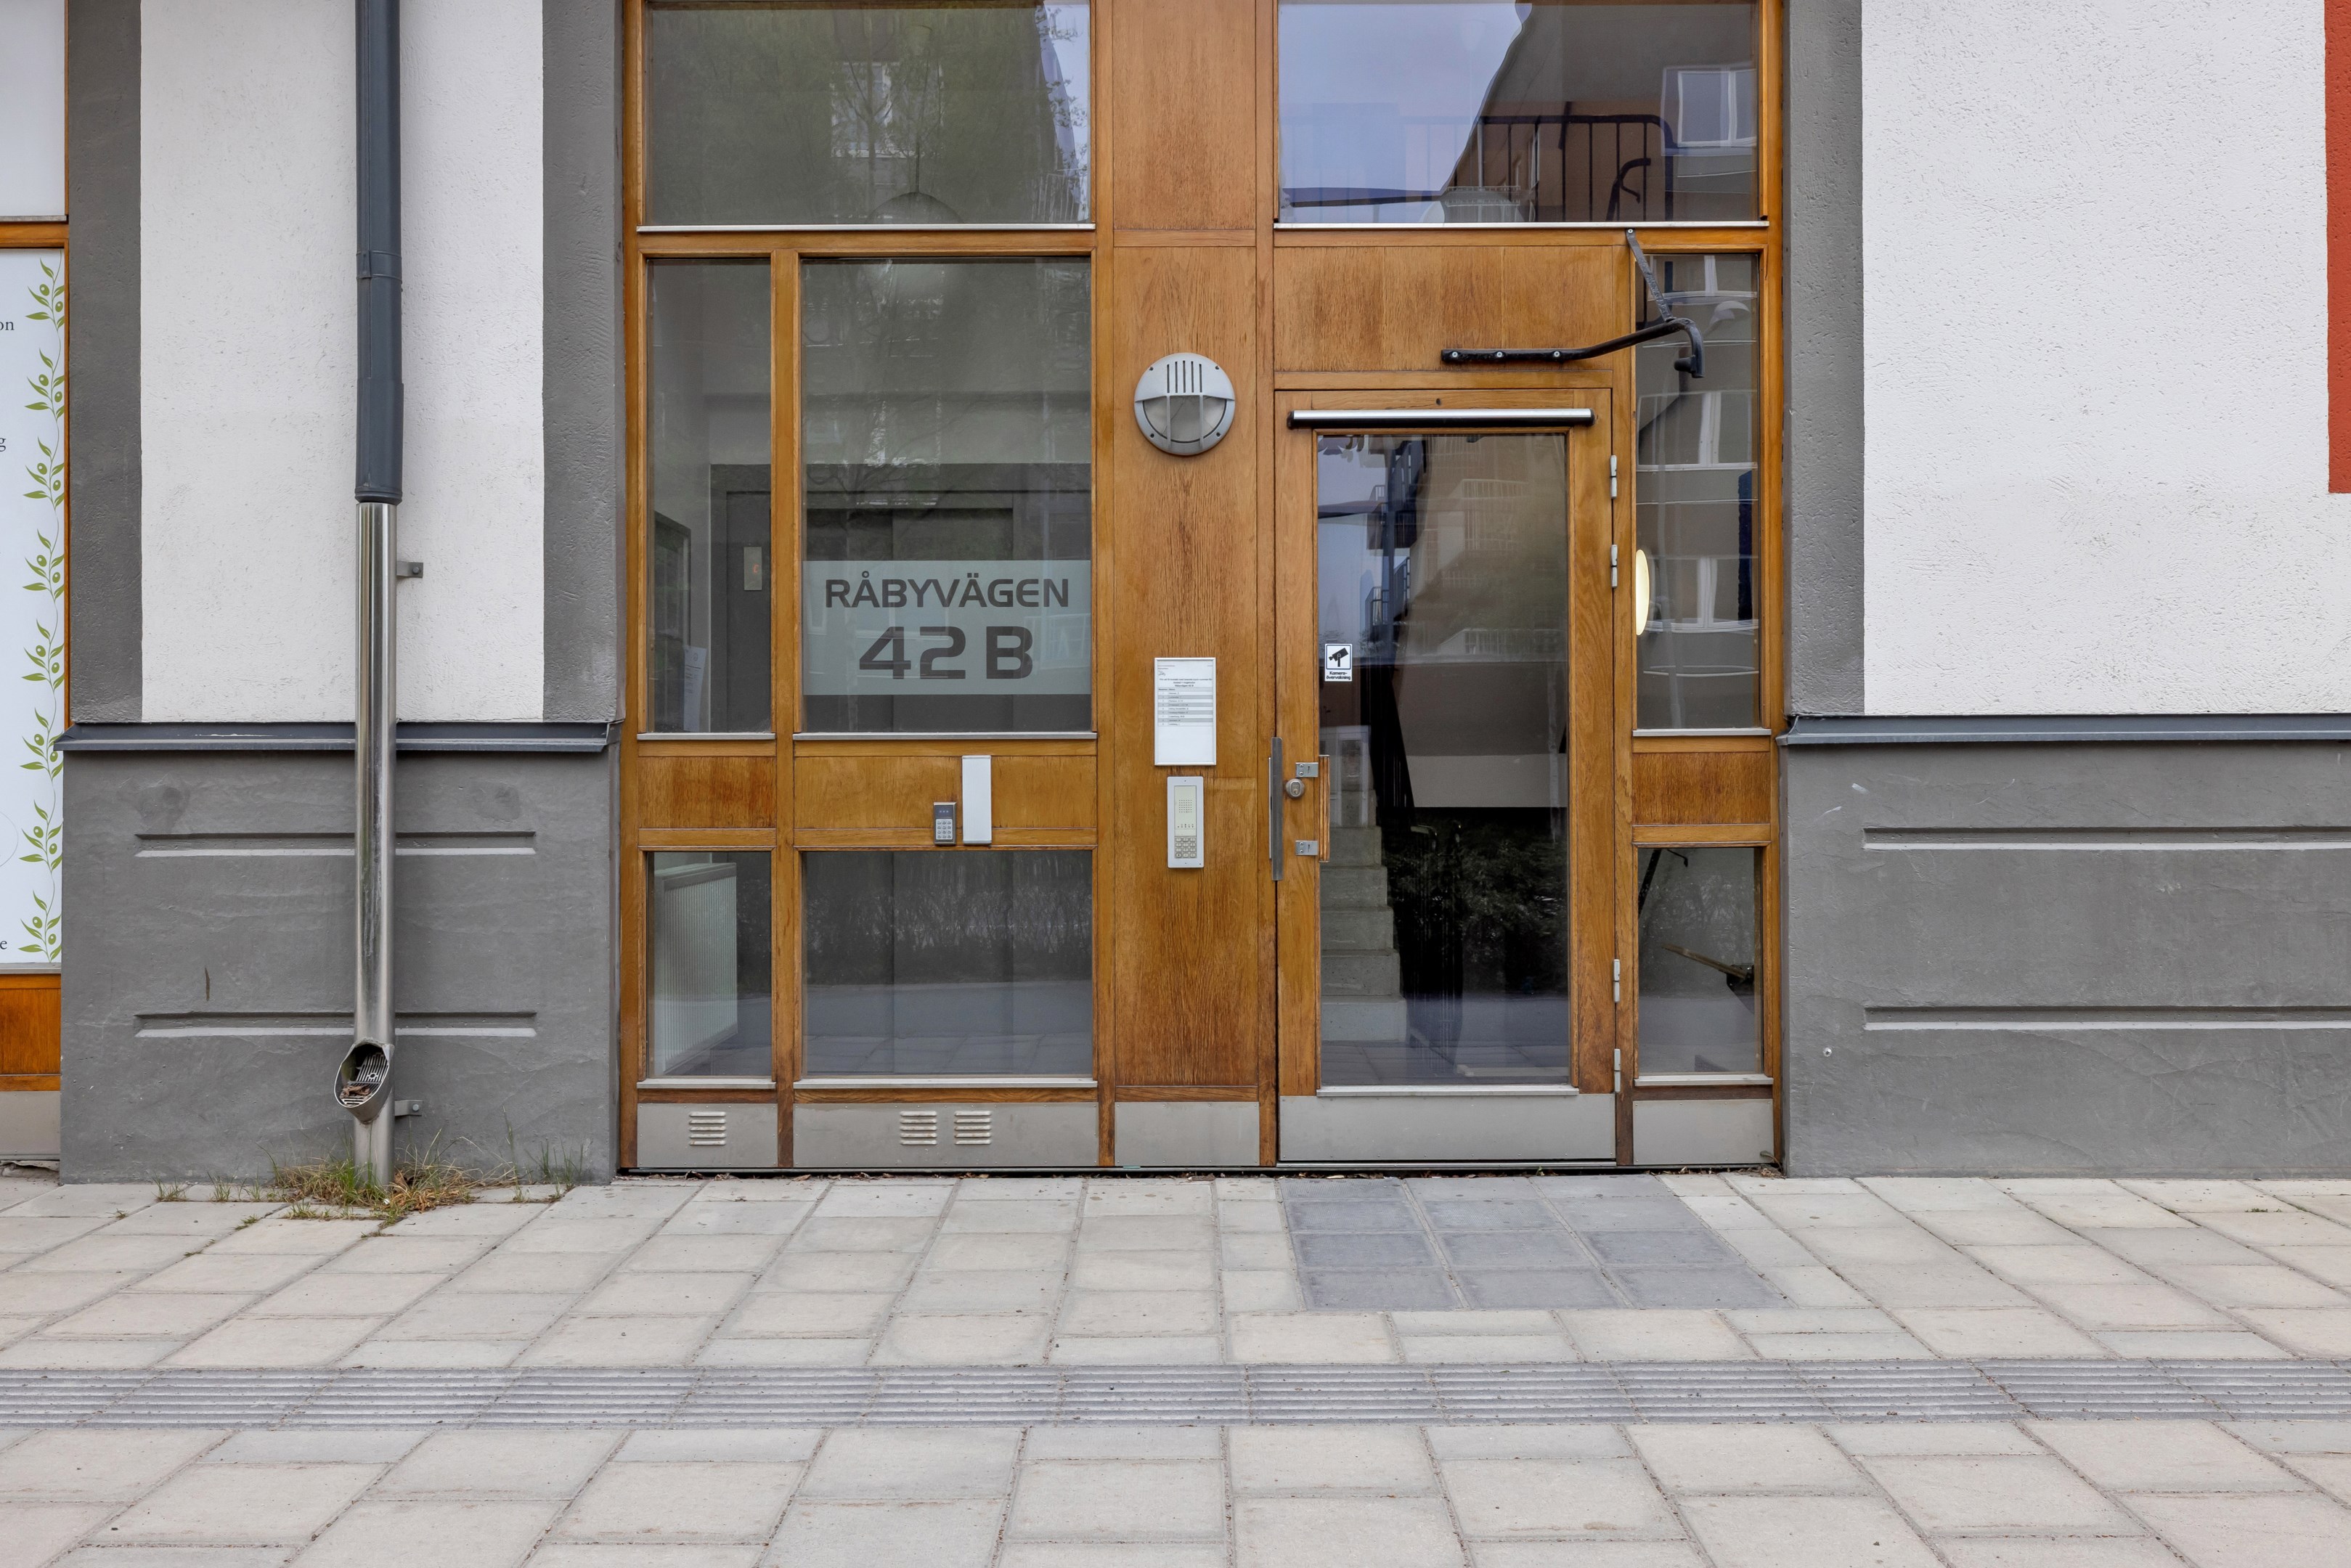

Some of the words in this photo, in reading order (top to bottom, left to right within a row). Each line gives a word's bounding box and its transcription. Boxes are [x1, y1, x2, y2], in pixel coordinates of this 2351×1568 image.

[825, 570, 1069, 608] RÅBYVÄGEN
[859, 626, 966, 680] 42
[985, 626, 1034, 680] B
